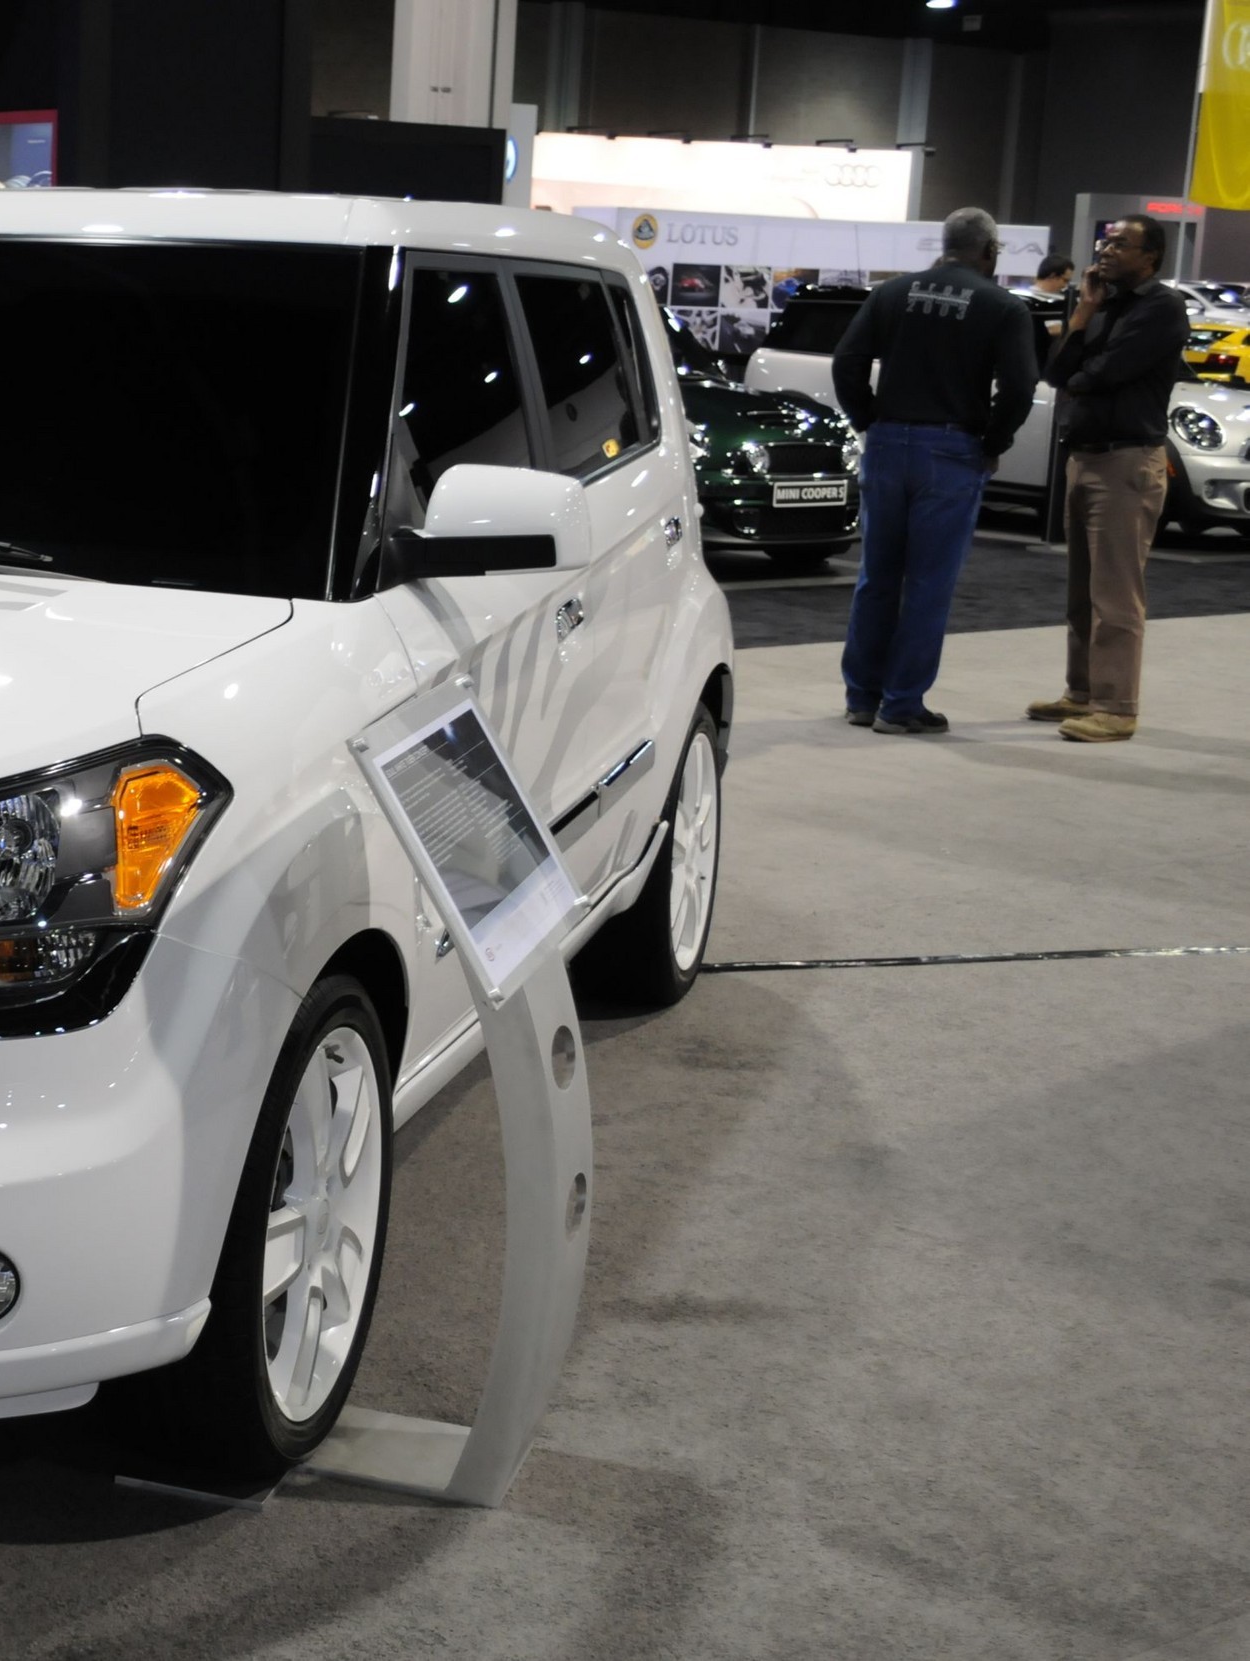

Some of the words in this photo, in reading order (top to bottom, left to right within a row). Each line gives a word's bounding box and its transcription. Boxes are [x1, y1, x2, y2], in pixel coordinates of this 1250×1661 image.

[666, 223, 739, 247] LOTUS
[776, 487, 801, 500] MINI
[801, 486, 838, 500] COOPER
[838, 486, 845, 498] S
